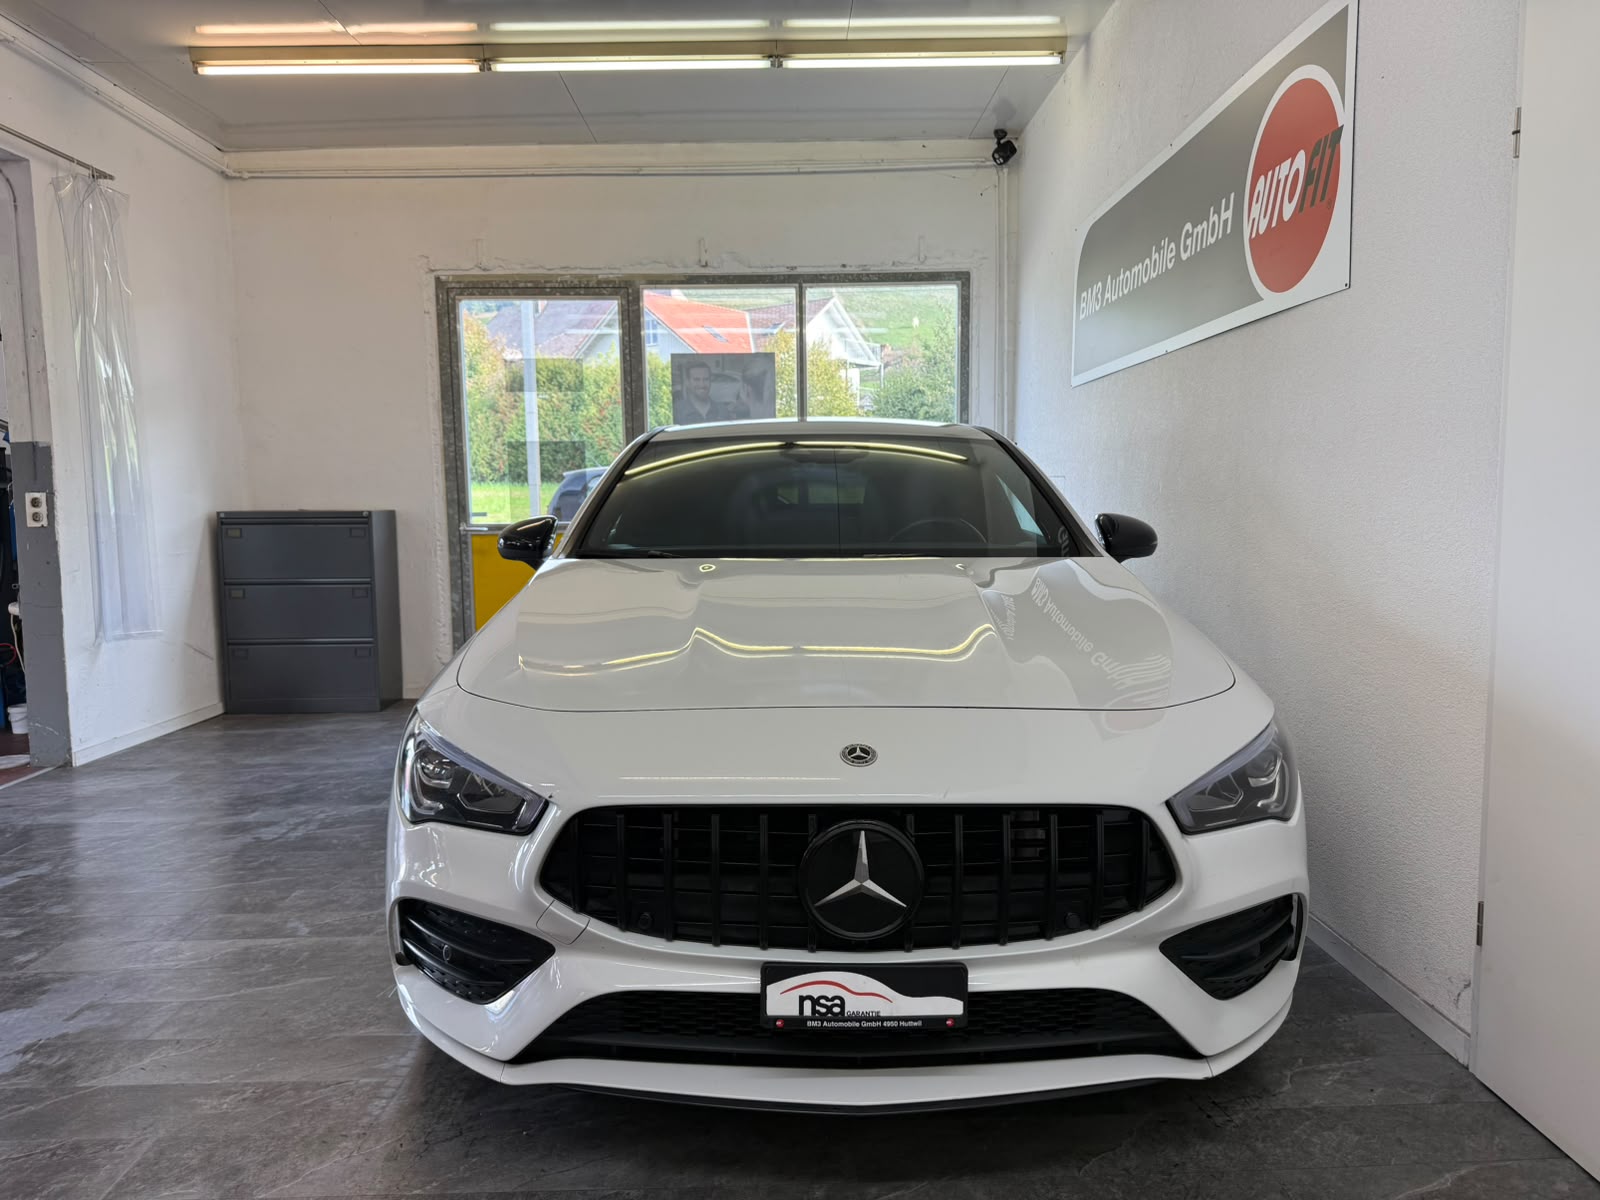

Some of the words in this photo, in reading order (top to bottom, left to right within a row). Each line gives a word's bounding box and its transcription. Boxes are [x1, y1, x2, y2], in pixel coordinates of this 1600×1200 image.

[1248, 124, 1344, 239] AUTOFIT
[1079, 281, 1102, 320] BM3
[1103, 237, 1176, 306] Automobile
[1180, 192, 1235, 261] GmbH
[798, 994, 846, 1017] nsa
[822, 1020, 860, 1028] Automobile
[861, 1020, 882, 1028] GmbH
[883, 1020, 899, 1028] 4950
